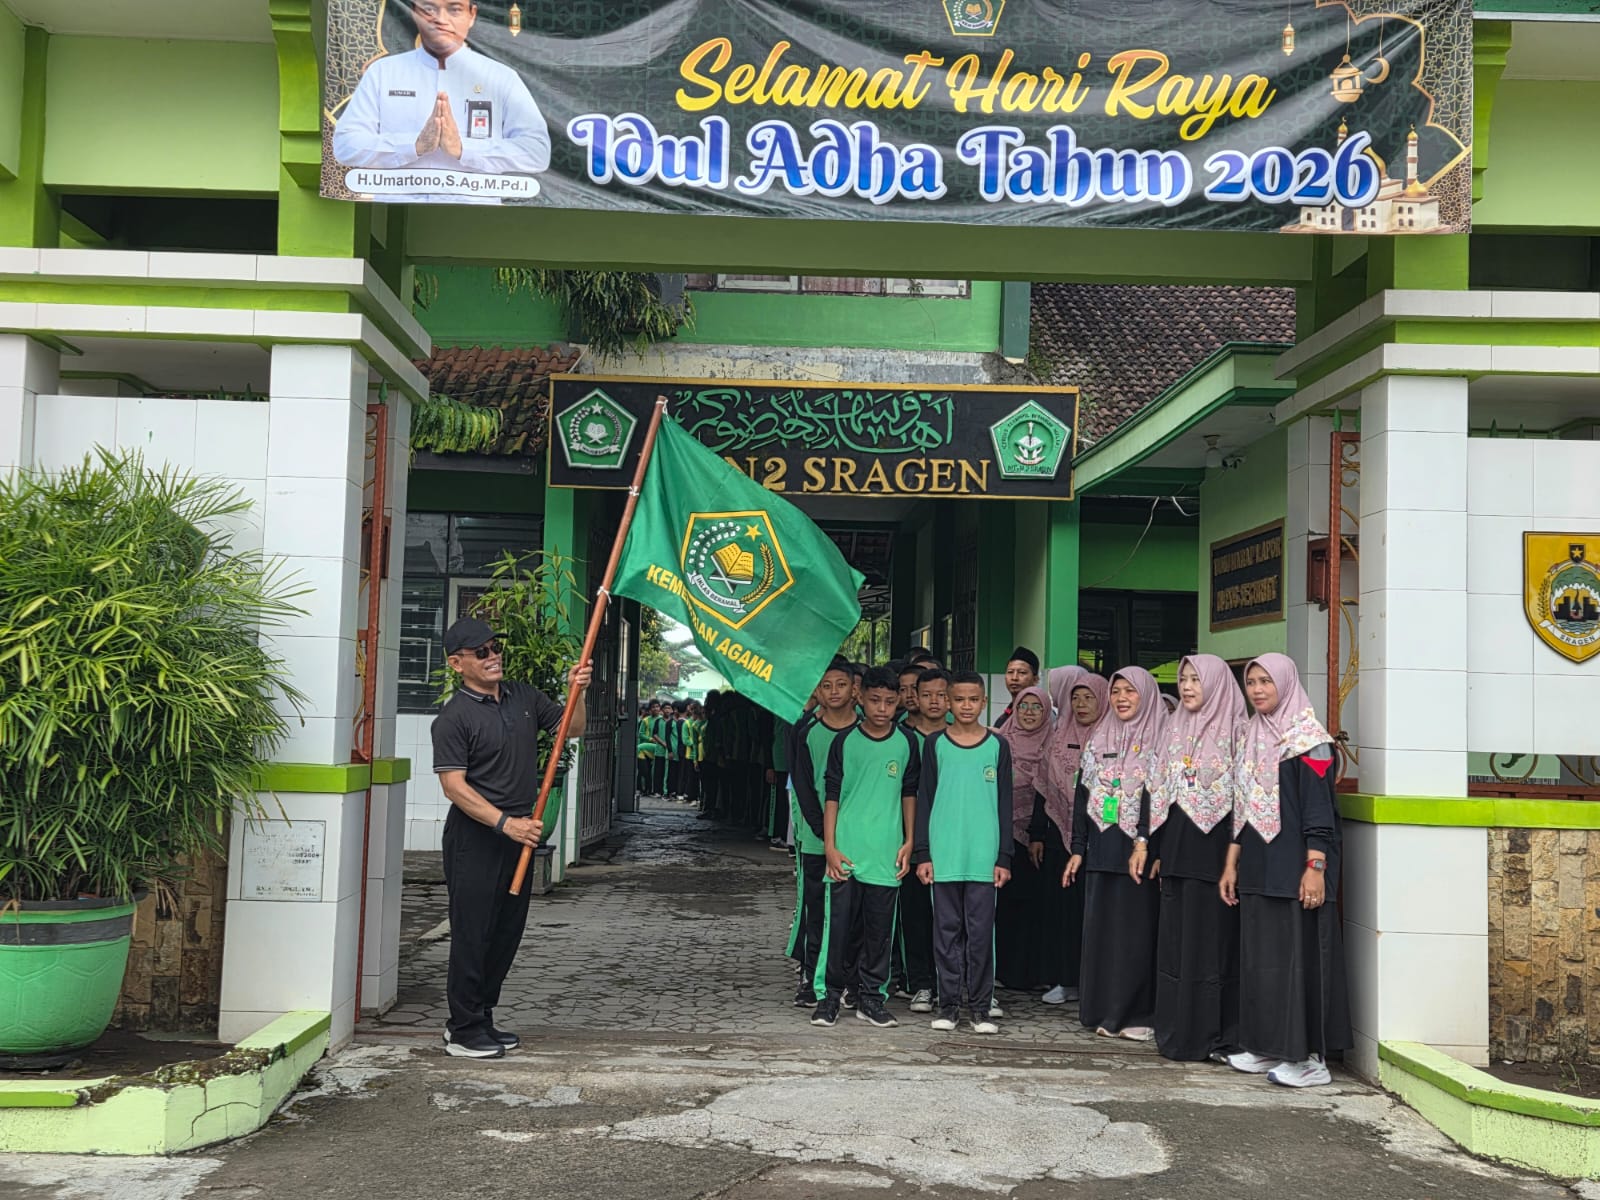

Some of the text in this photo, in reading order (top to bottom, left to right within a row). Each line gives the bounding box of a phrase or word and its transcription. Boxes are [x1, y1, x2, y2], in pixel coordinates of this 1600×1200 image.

[675, 38, 1276, 141] Selamat Hari Raya
[568, 113, 1380, 206] Idul Adha Tahun 2026
[803, 457, 990, 493] SRAGEN
[716, 637, 773, 682] AGAMA
[1560, 634, 1596, 645] SRAGEN
